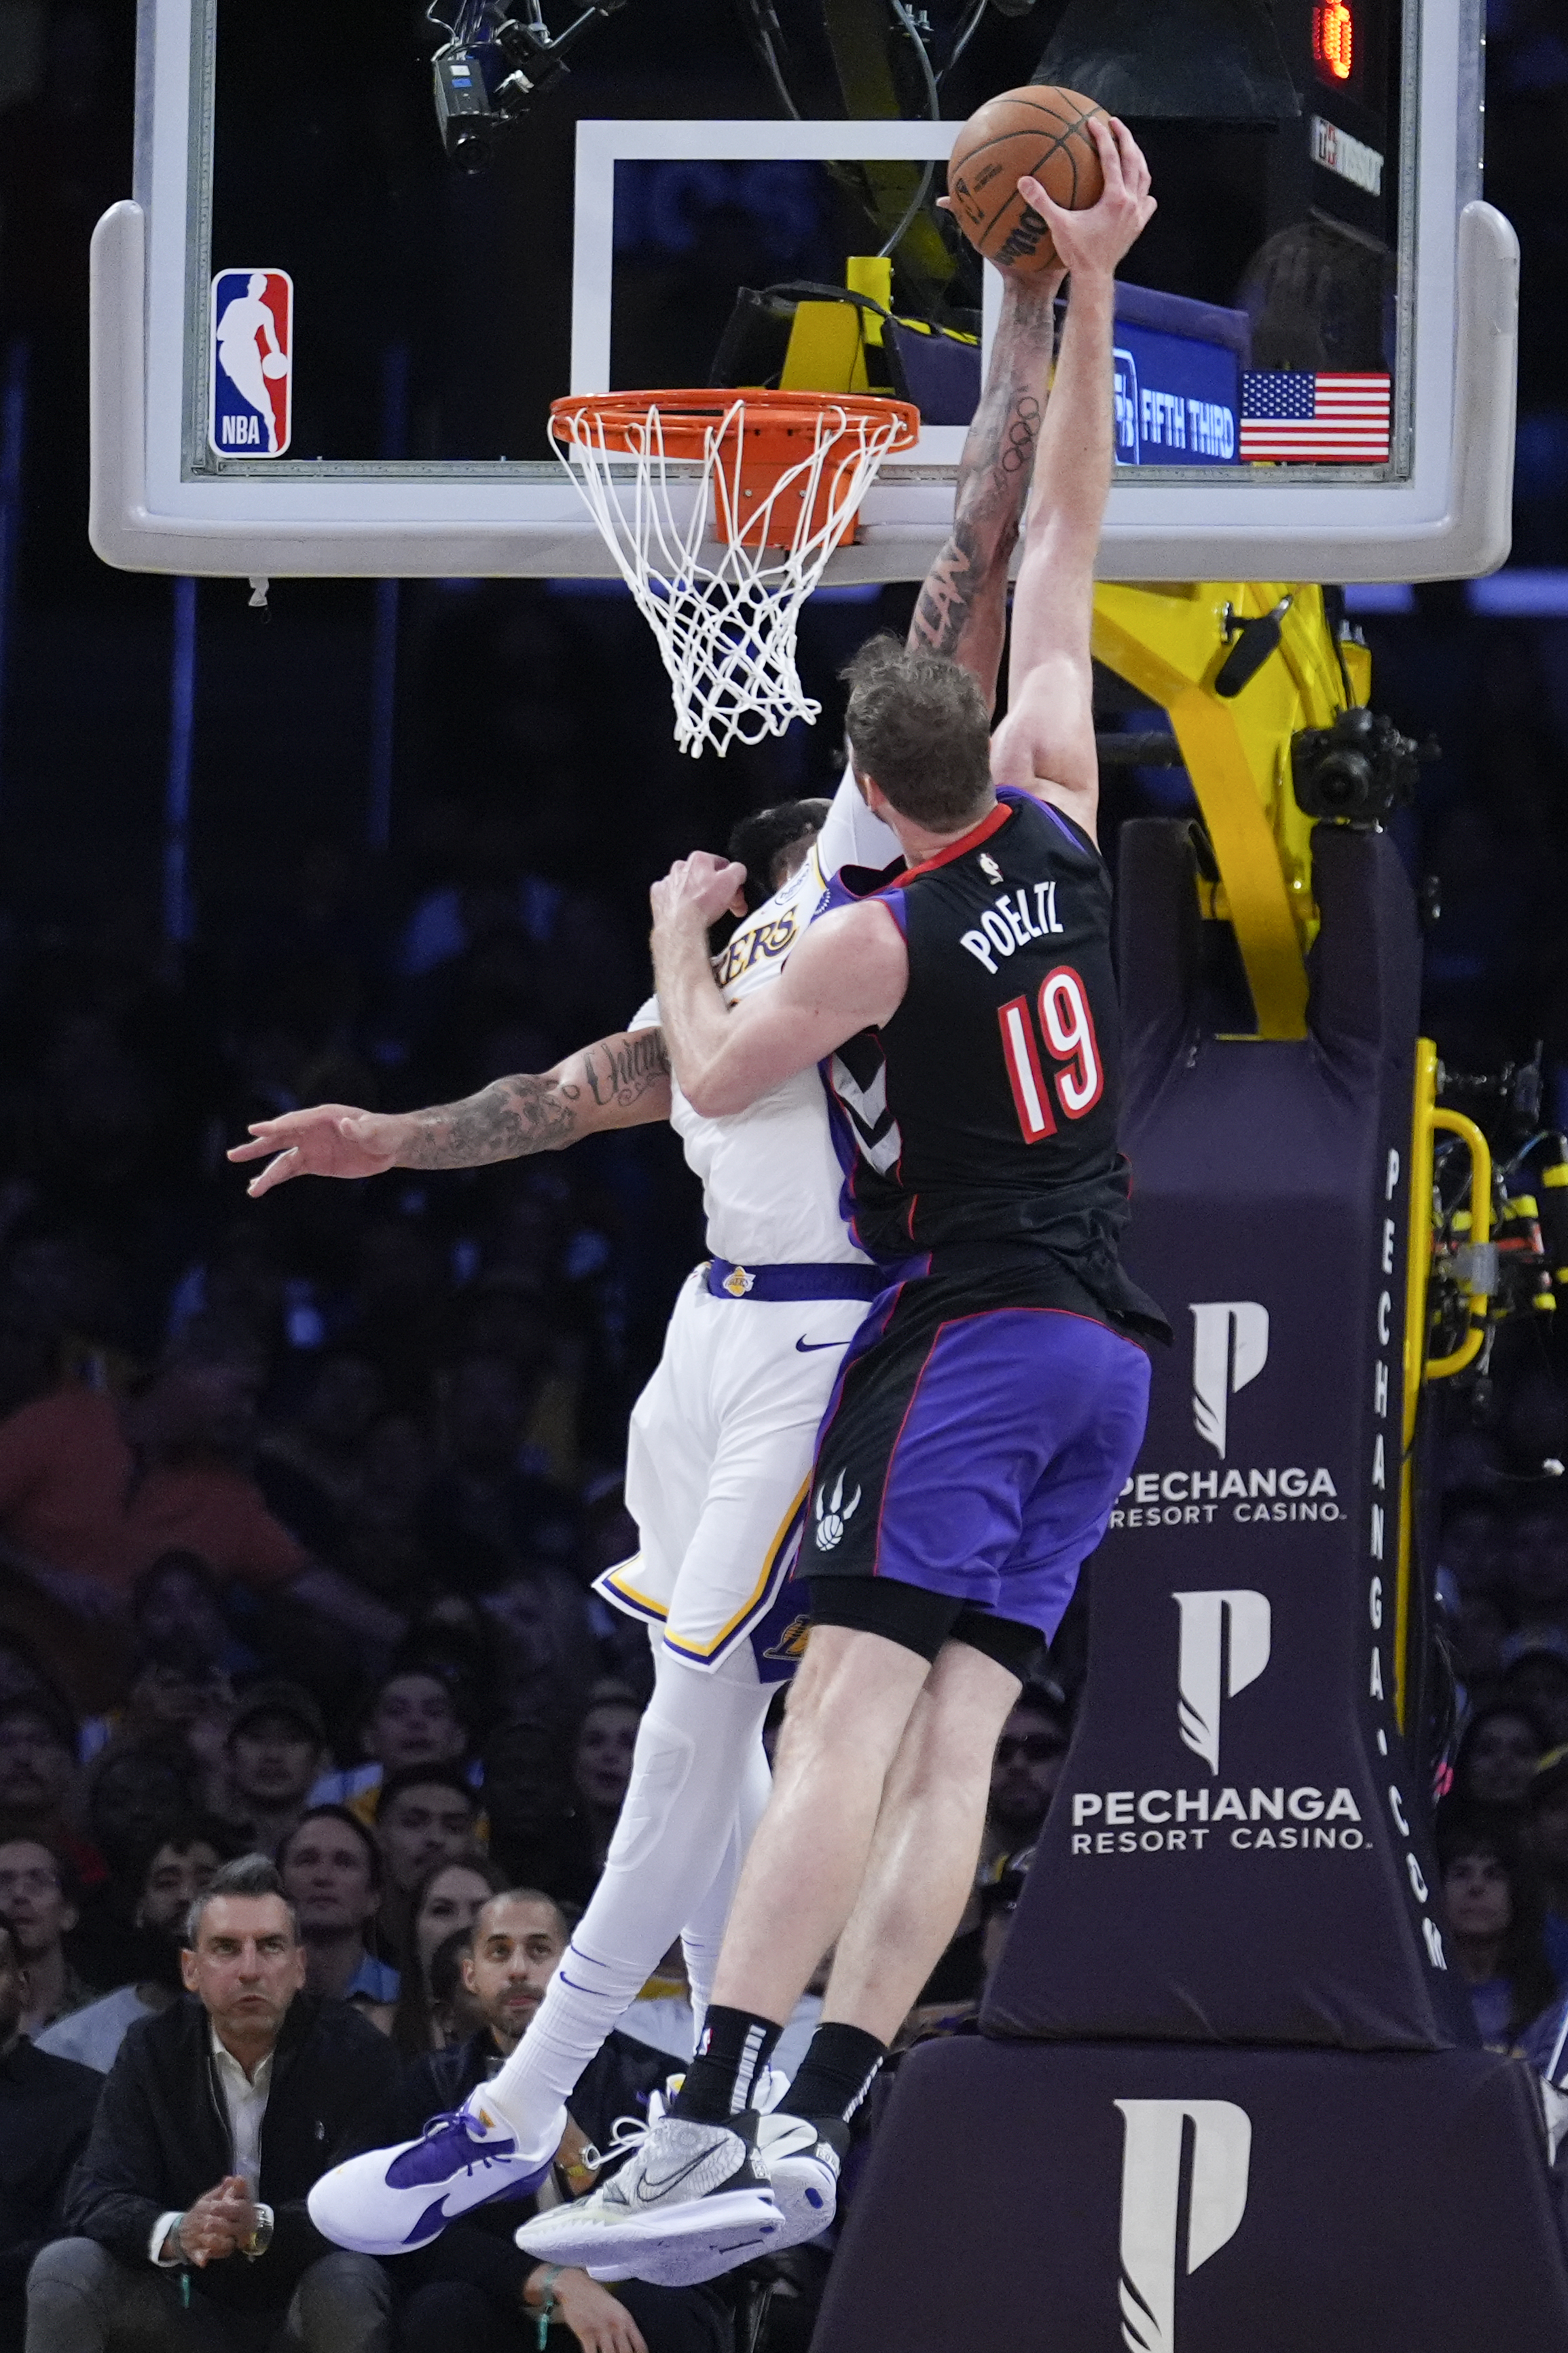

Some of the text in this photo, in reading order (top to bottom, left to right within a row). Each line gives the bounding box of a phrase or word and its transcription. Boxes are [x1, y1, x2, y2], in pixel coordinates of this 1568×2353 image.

[222, 414, 261, 445] NBA
[1141, 387, 1234, 461] FIFTH THIRD
[960, 881, 1064, 975] POELTL
[998, 965, 1104, 1145] 19
[1108, 1502, 1341, 1529] RESORT CASINO
[1072, 1786, 1362, 1827] PECHANGA
[1072, 1827, 1364, 1855] RESORT CASINO
